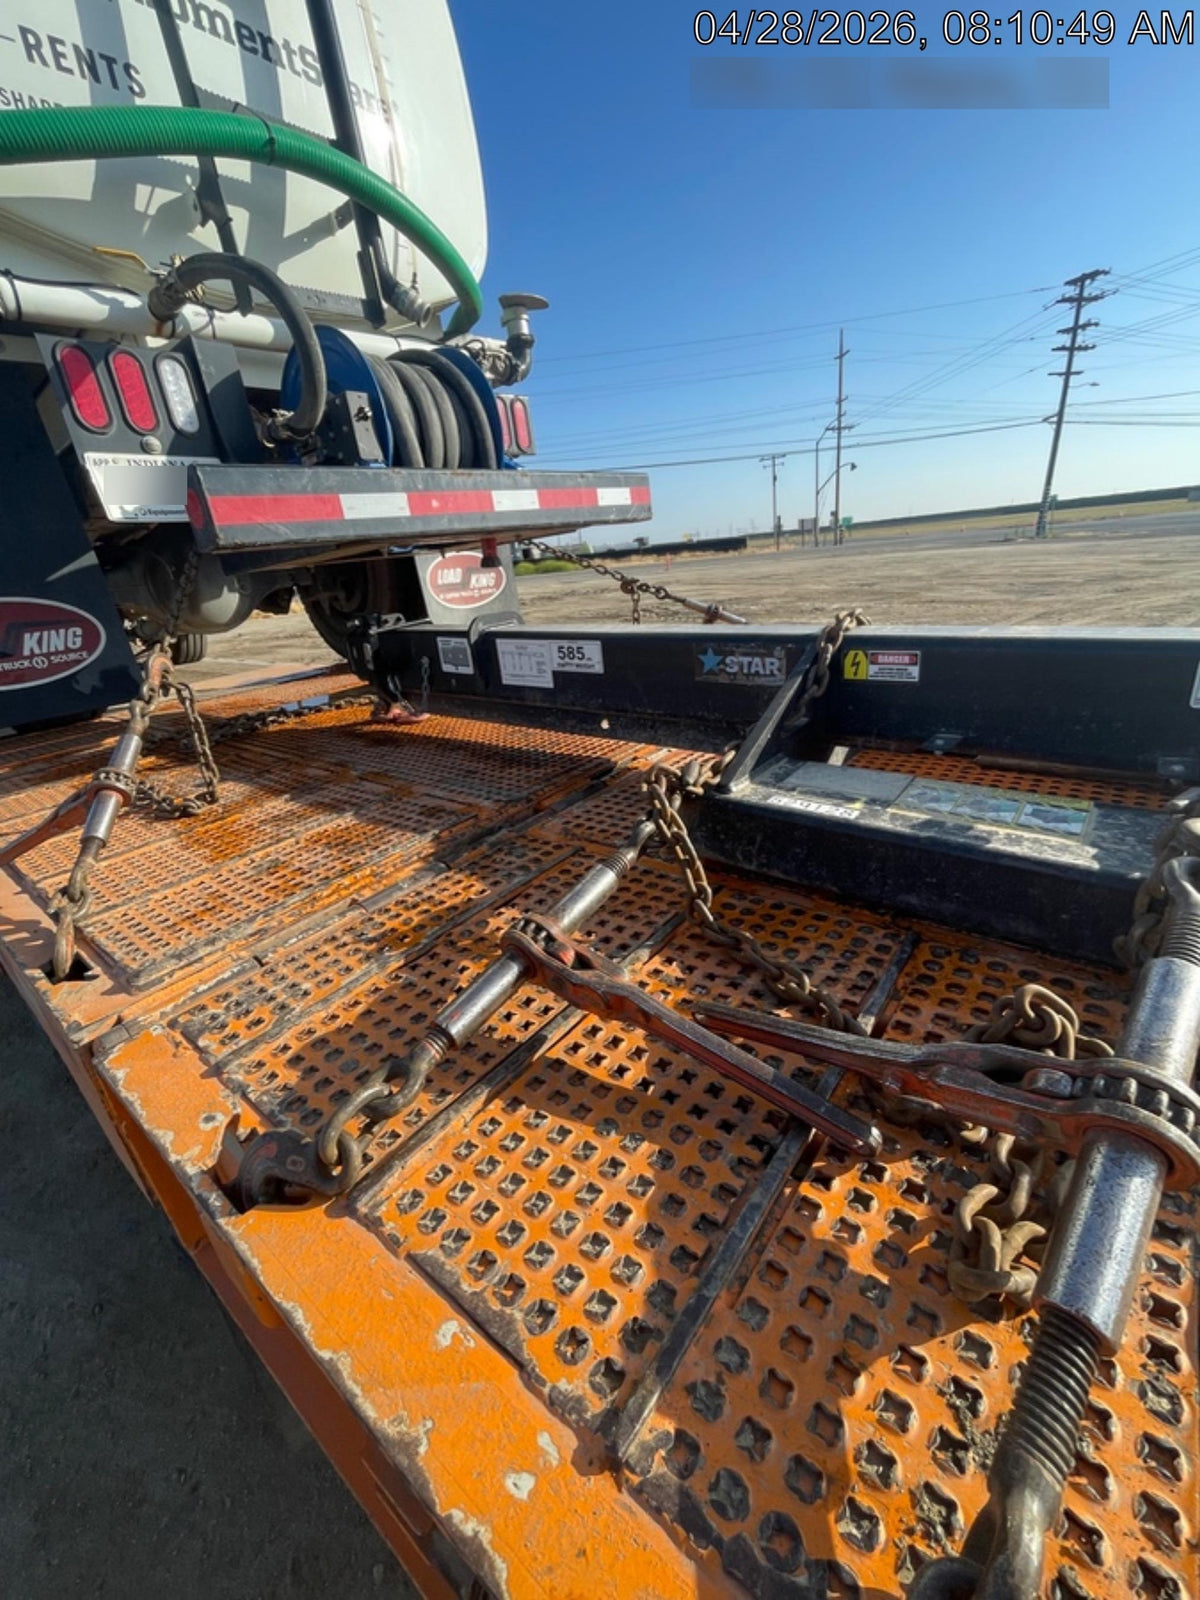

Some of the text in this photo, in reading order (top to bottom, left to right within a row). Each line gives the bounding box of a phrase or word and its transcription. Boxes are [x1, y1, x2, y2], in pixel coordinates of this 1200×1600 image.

[17, 24, 147, 99] RENTS
[22, 627, 83, 656] KING
[557, 644, 586, 661] 585
[878, 655, 910, 664] DANGER
[725, 655, 781, 675] STAR
